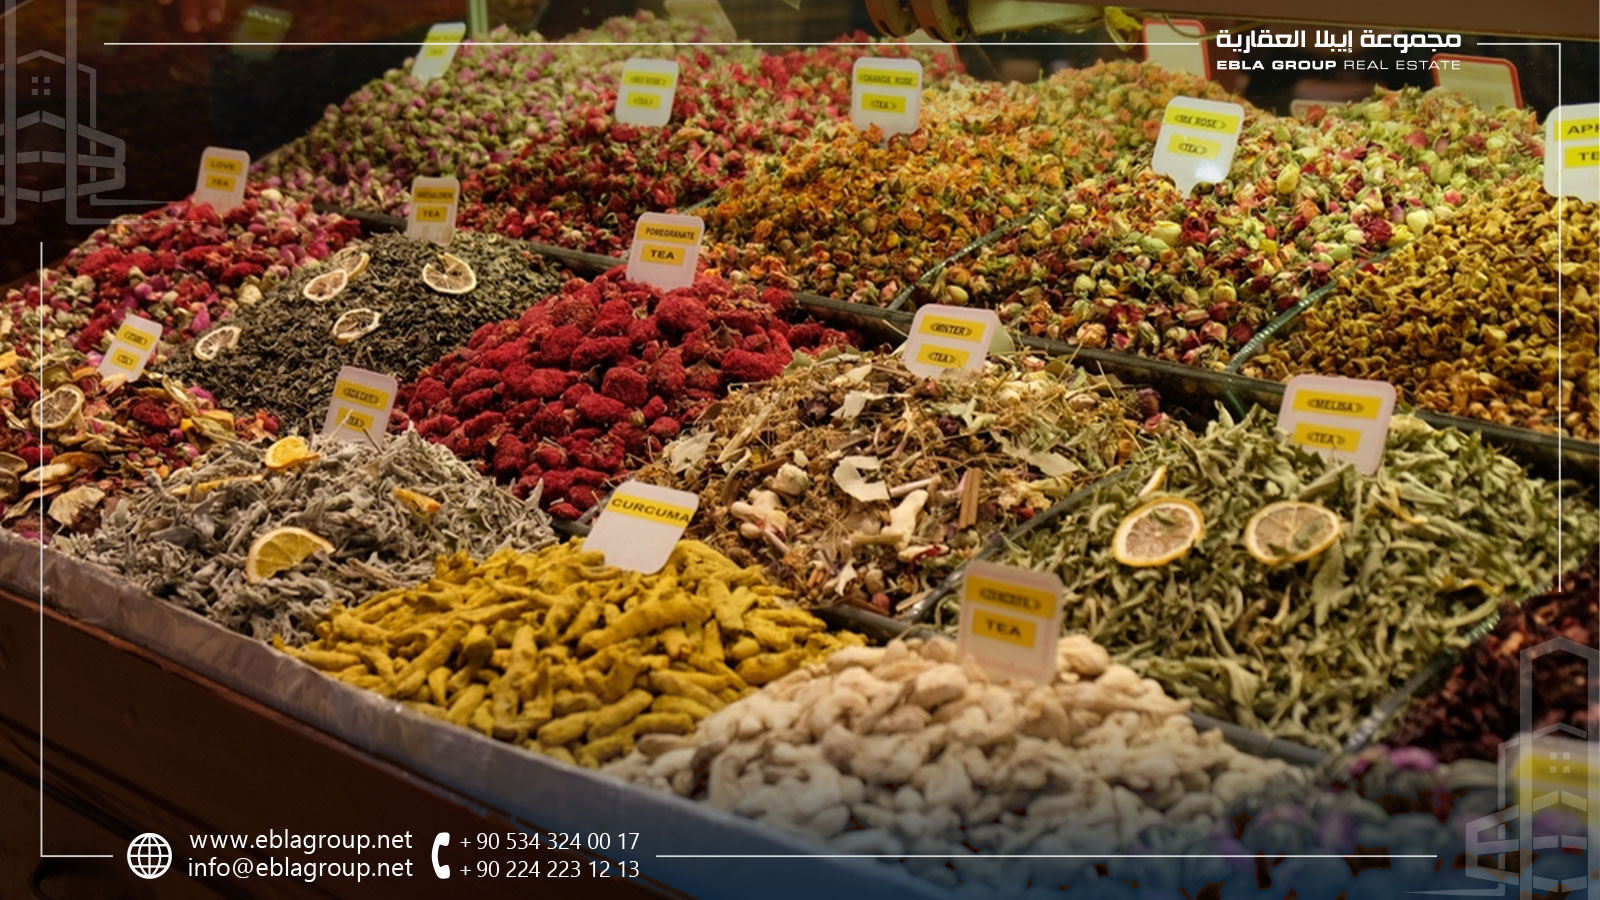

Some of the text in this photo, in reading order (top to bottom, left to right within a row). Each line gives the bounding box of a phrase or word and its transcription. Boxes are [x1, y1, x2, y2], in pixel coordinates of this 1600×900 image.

[210, 159, 236, 171] LOVE
[212, 177, 230, 187] TEA
[422, 209, 441, 218] TEA
[645, 226, 696, 241] POMEGRANATE
[650, 249, 676, 261] TEA
[1315, 397, 1354, 412] MELISA
[611, 497, 690, 524] CURCUMA
[985, 619, 1023, 638] TEA
